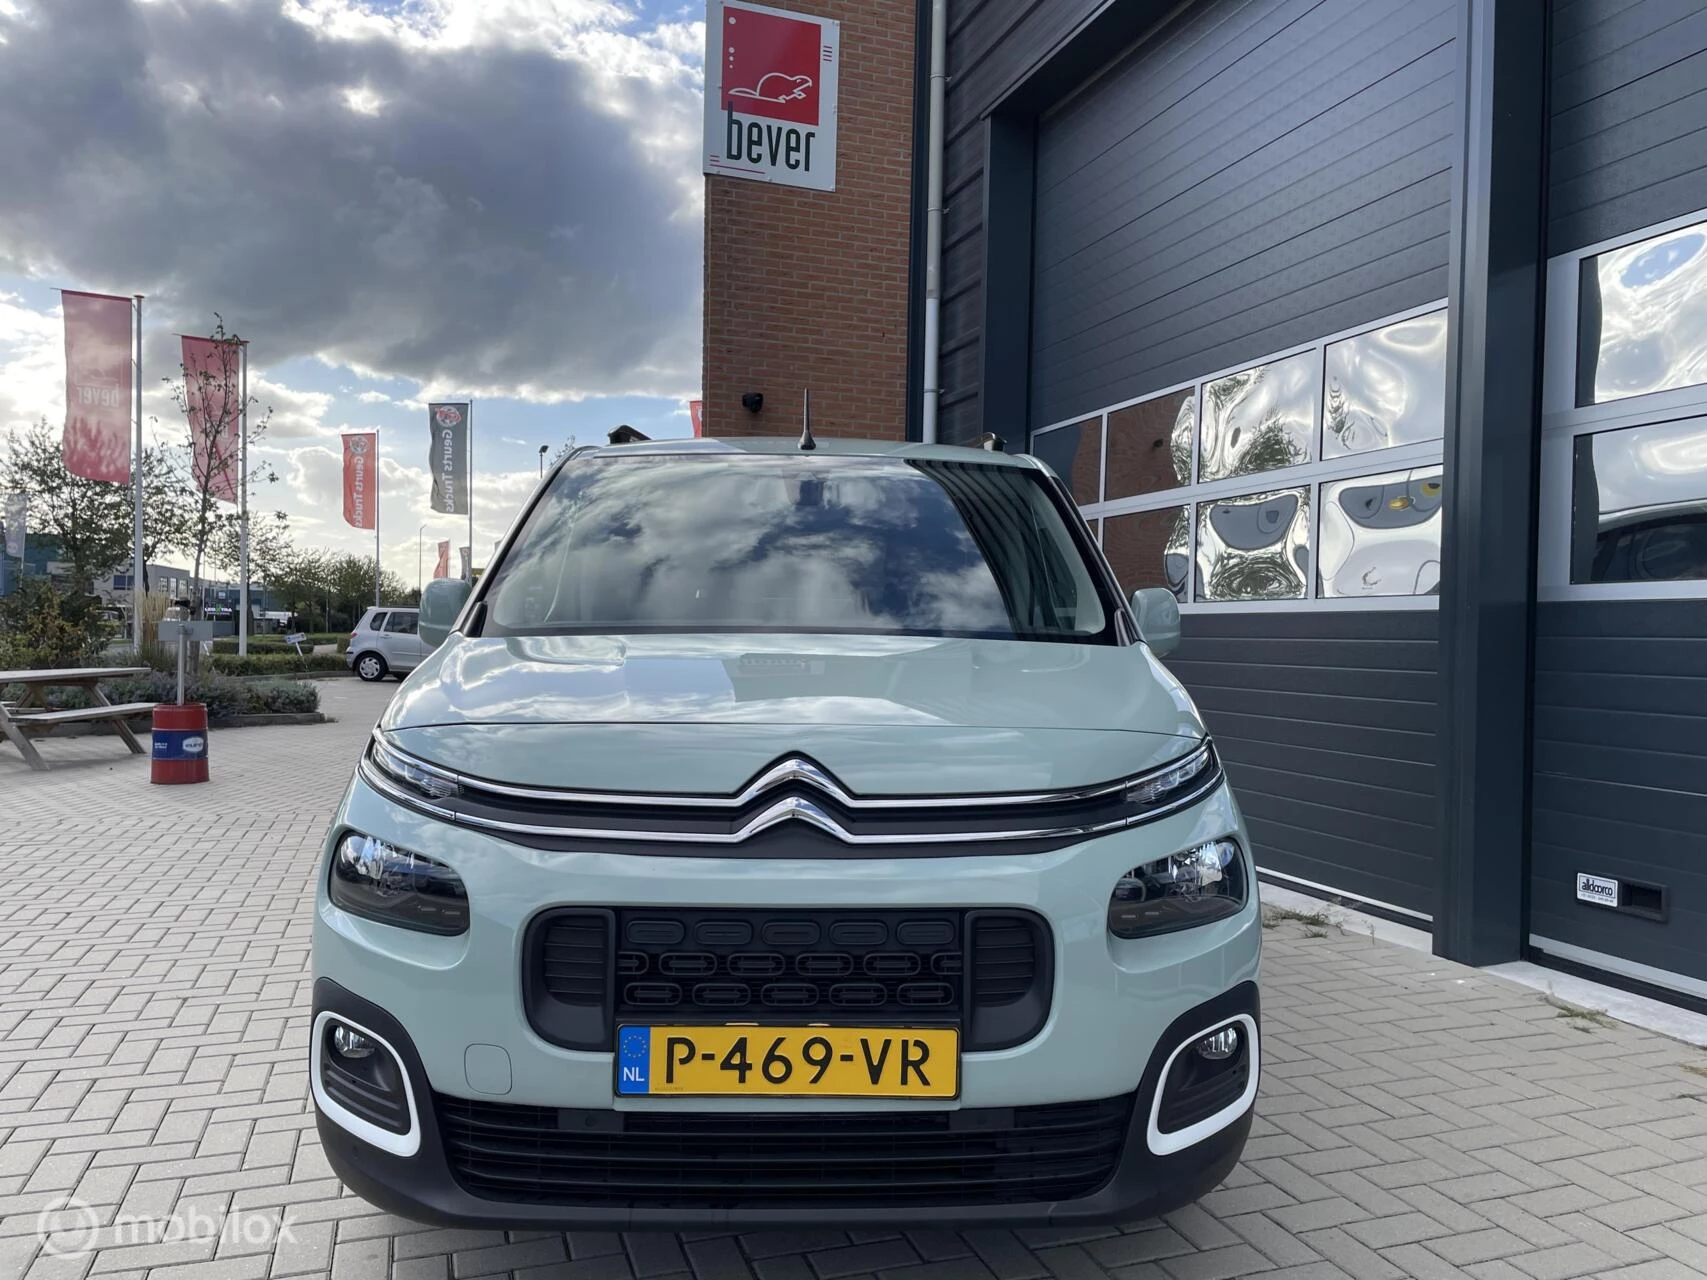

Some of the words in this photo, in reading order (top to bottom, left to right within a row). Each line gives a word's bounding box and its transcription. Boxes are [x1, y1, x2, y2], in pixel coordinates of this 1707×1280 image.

[726, 101, 815, 172] bever
[623, 1066, 645, 1082] NL
[665, 1036, 931, 1086] P-469-VR
